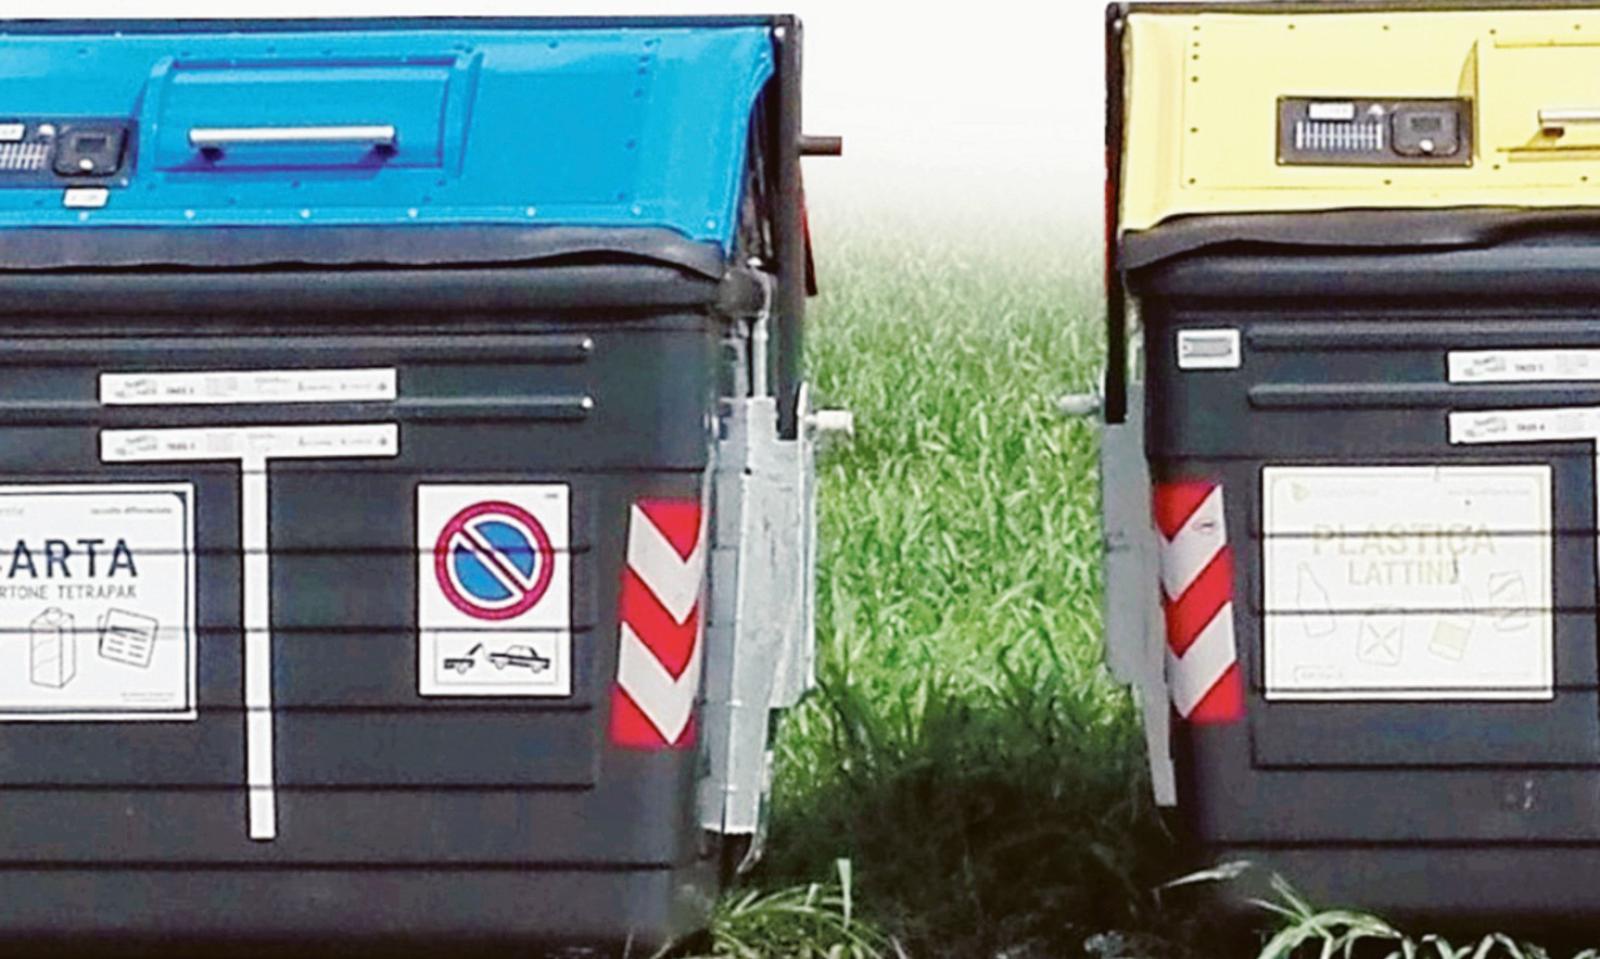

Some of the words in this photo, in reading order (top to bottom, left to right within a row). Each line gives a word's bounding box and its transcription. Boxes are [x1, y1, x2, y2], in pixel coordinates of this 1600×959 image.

[1313, 523, 1496, 555] PLASTICA
[0, 538, 138, 578] ARTA
[58, 584, 138, 600] TETRAPAK
